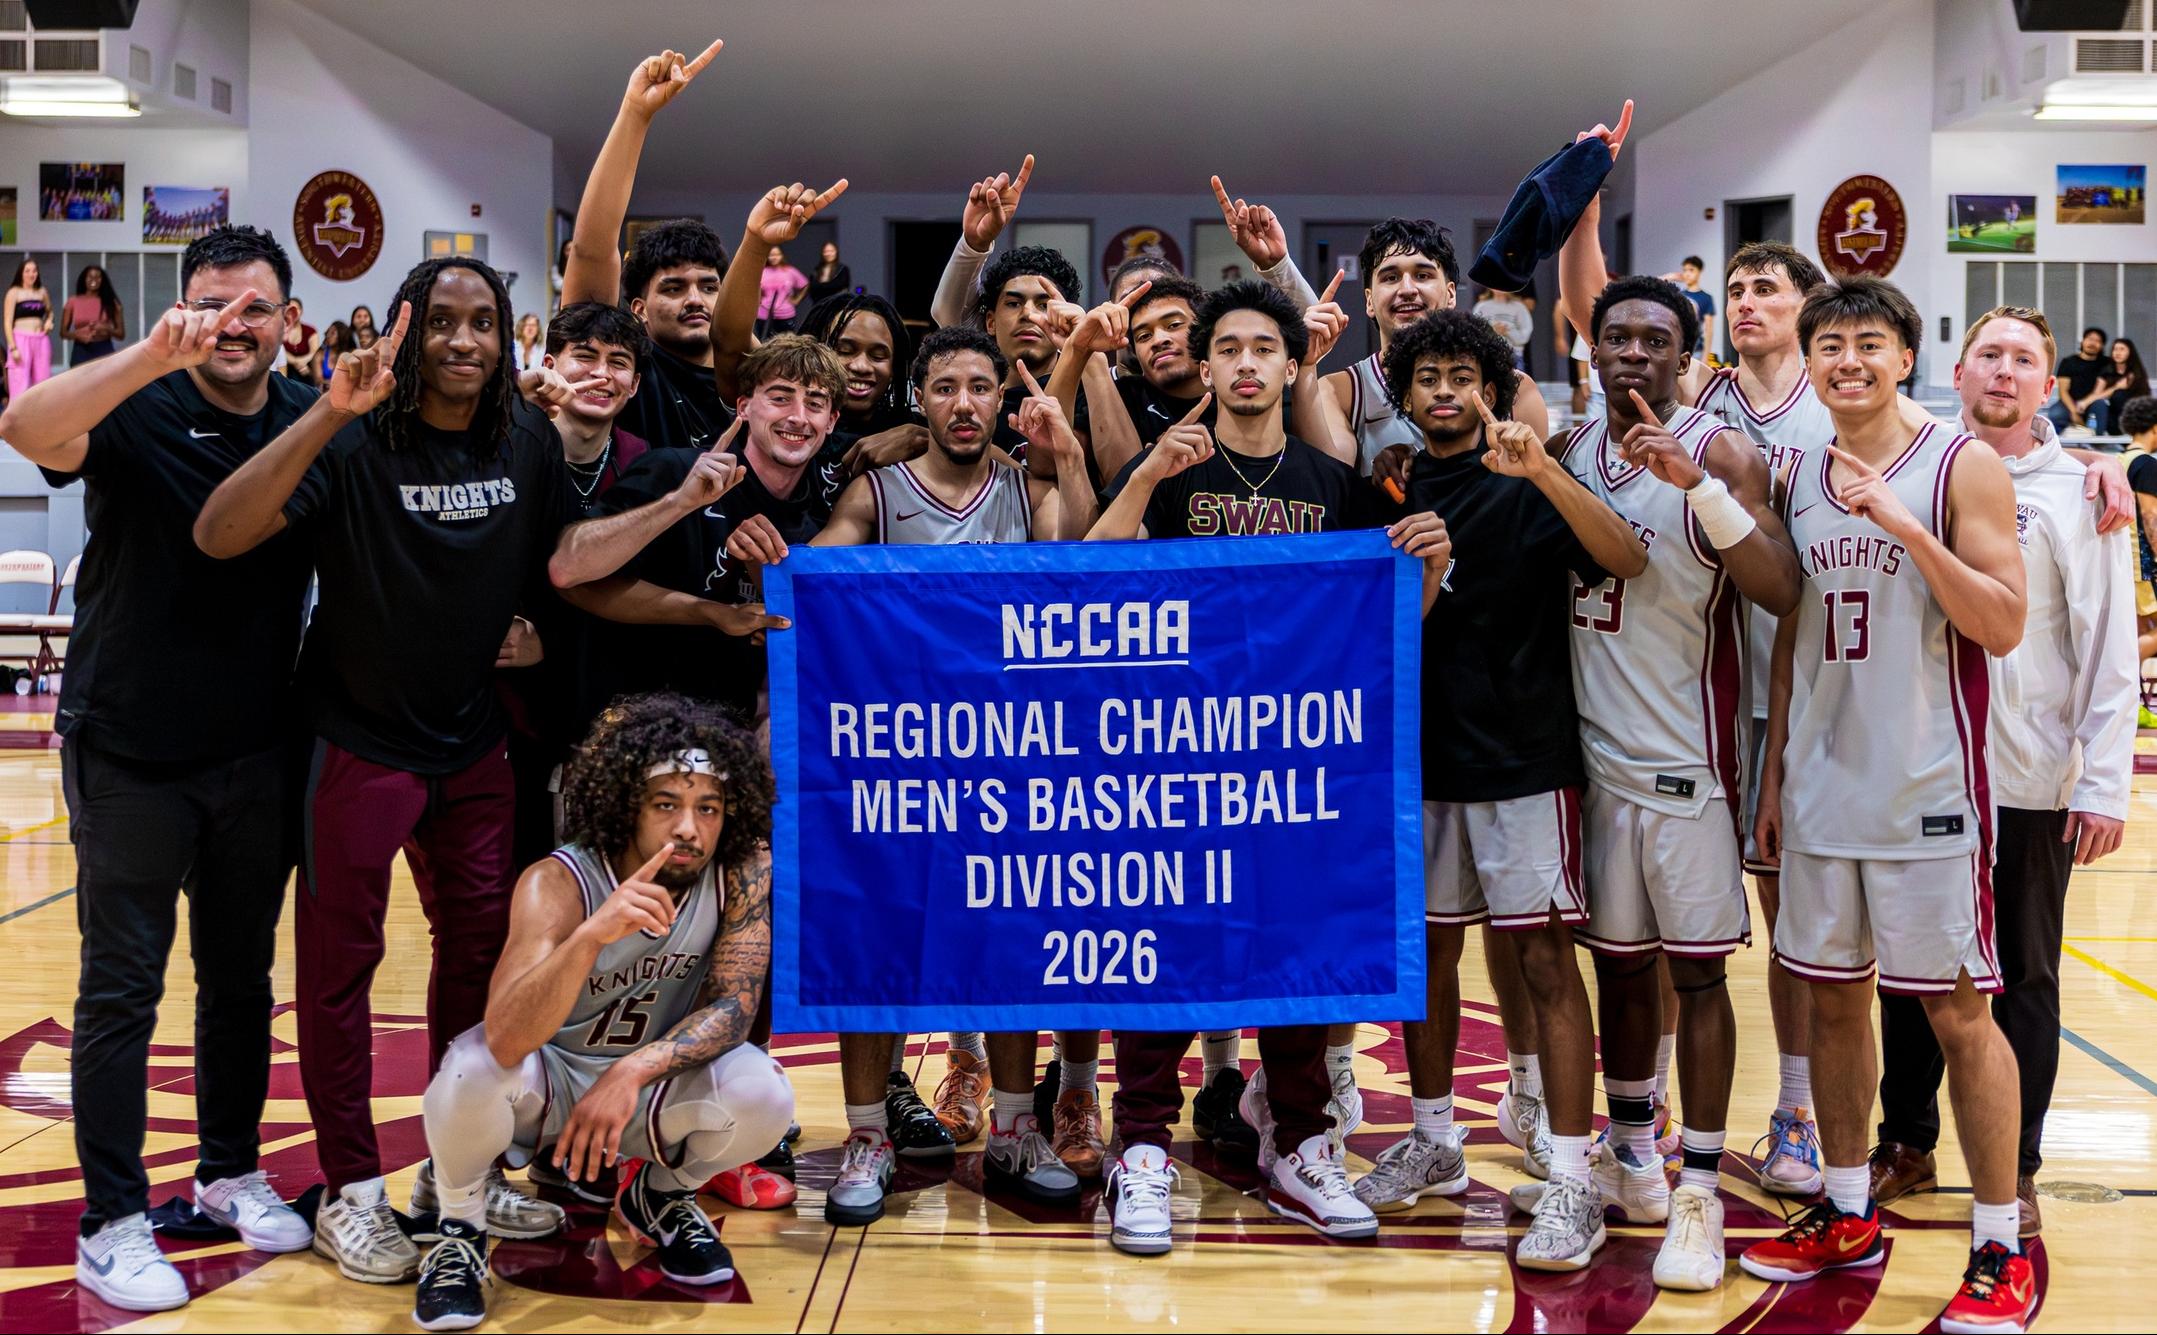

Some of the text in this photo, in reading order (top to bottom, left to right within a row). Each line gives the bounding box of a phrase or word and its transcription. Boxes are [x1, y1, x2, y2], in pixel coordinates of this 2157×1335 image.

[399, 477, 516, 512] KNIGHTS
[438, 507, 489, 521] ATHLETICS
[1001, 600, 1190, 659] NCCAA
[1571, 576, 1628, 636] 23
[1822, 588, 1871, 664] 13
[830, 688, 1363, 759] REGIONAL CHAMPION
[852, 766, 1340, 834] MEN'S BASKETBALL
[965, 849, 1232, 908] DIVISION II
[1043, 928, 1158, 986] 2026
[583, 990, 660, 1048] 15
